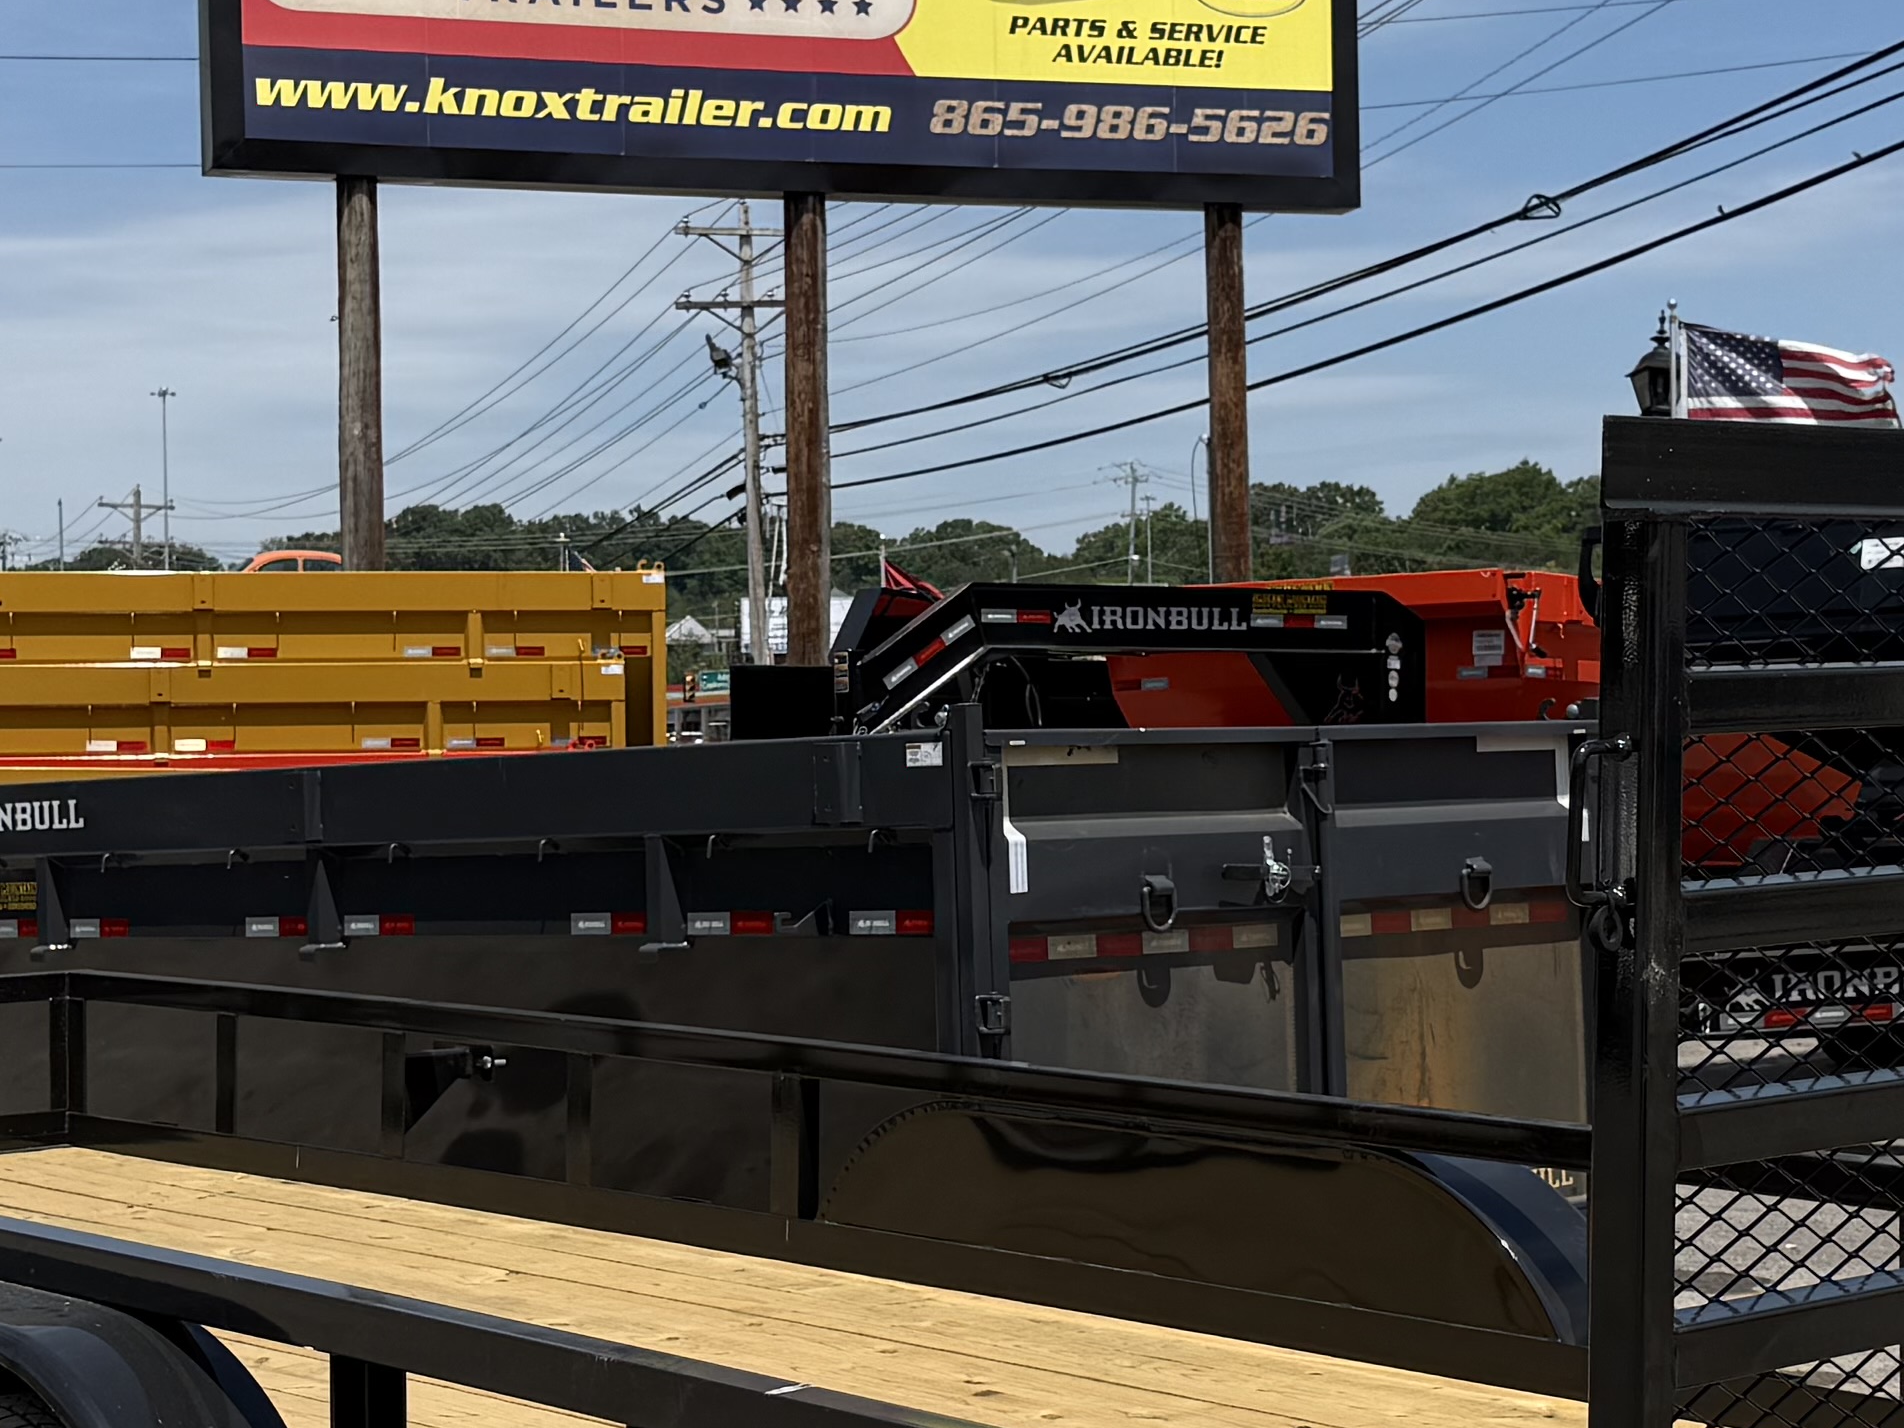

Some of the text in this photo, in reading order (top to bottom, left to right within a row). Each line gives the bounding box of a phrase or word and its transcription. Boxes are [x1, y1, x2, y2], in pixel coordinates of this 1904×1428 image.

[1008, 15, 1268, 45] PARTS & SERVICE
[1052, 43, 1224, 69] AVAILABLE!
[255, 77, 892, 133] www.knoxtrailer.com
[929, 99, 1331, 147] 865-986-5626
[1090, 605, 1248, 631] IRONBULL
